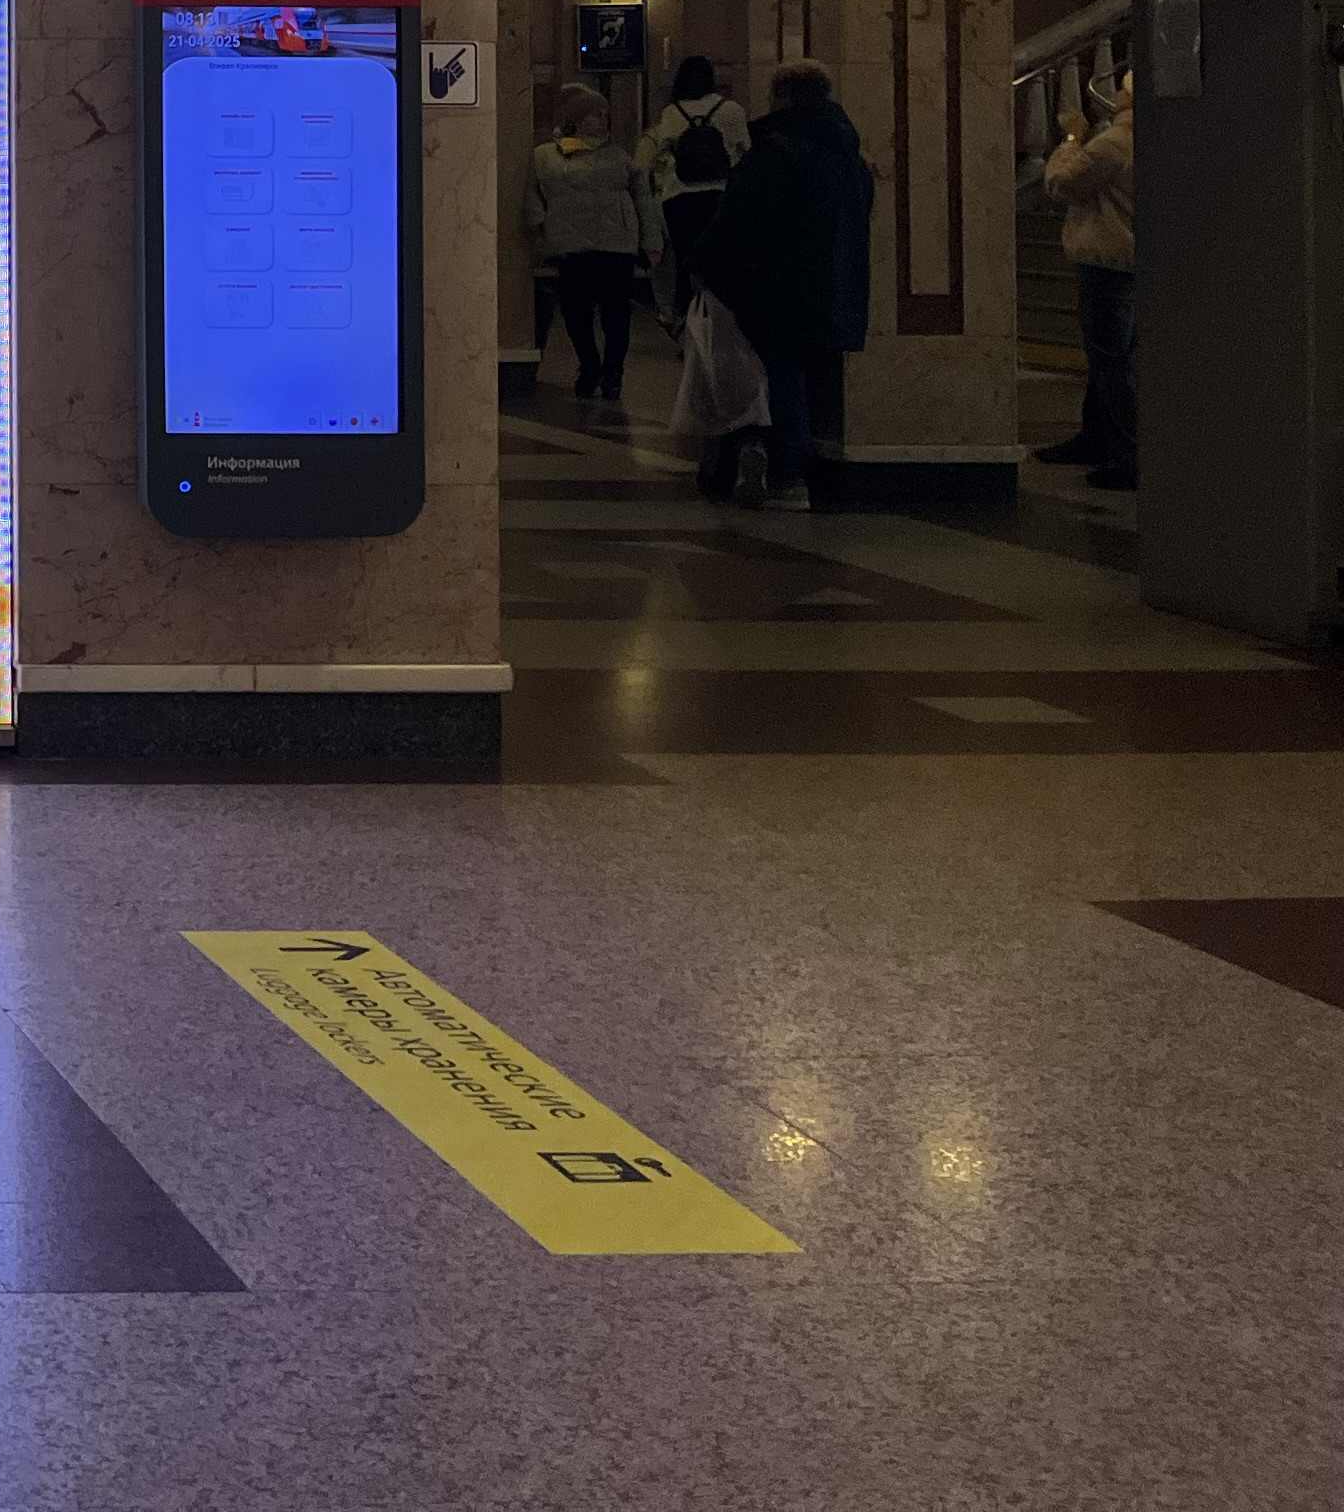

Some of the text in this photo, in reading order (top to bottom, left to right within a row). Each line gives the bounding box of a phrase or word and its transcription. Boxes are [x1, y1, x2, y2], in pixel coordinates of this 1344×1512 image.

[206, 456, 301, 471] Информация
[207, 473, 269, 484] Information
[305, 968, 540, 1133] камеры хранения
[313, 1021, 385, 1065] lockers
[362, 968, 586, 1121] Автоматические
